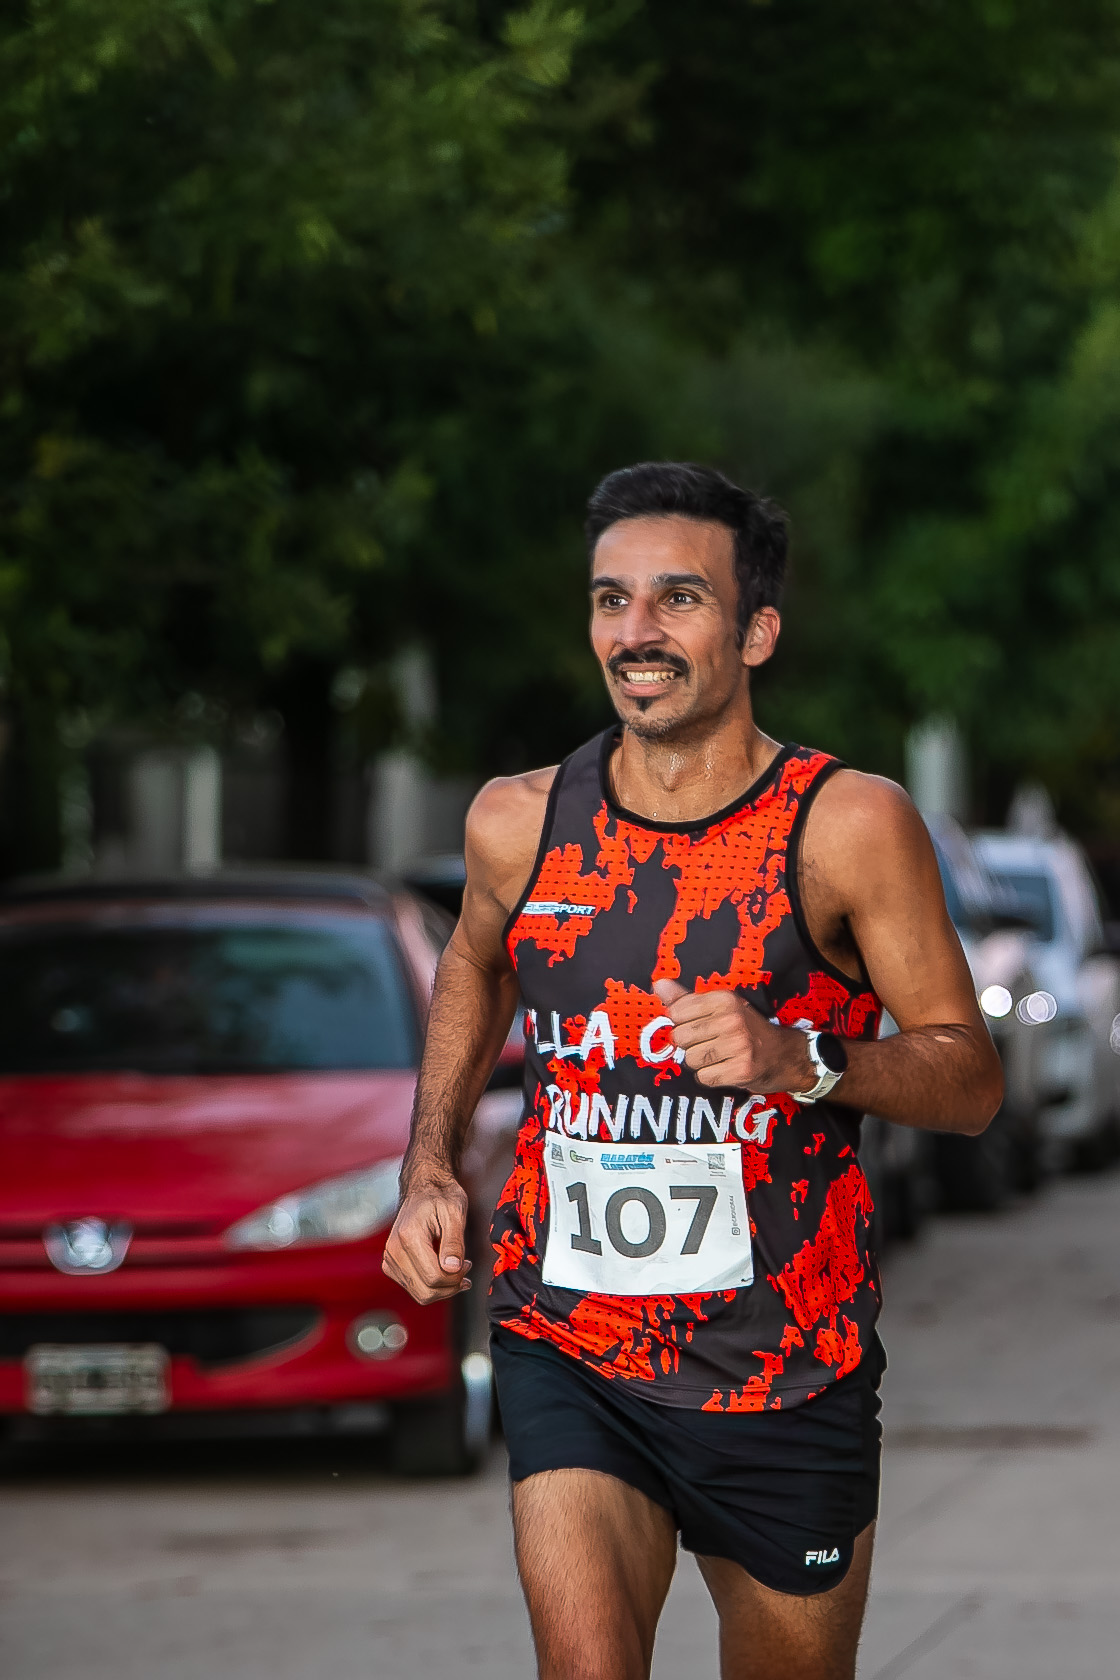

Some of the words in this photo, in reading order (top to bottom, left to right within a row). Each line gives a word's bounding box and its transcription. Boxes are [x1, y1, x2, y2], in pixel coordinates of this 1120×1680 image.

[545, 1083, 778, 1145] RUNNING
[565, 1181, 719, 1258] 107
[804, 1546, 840, 1567] FILA
